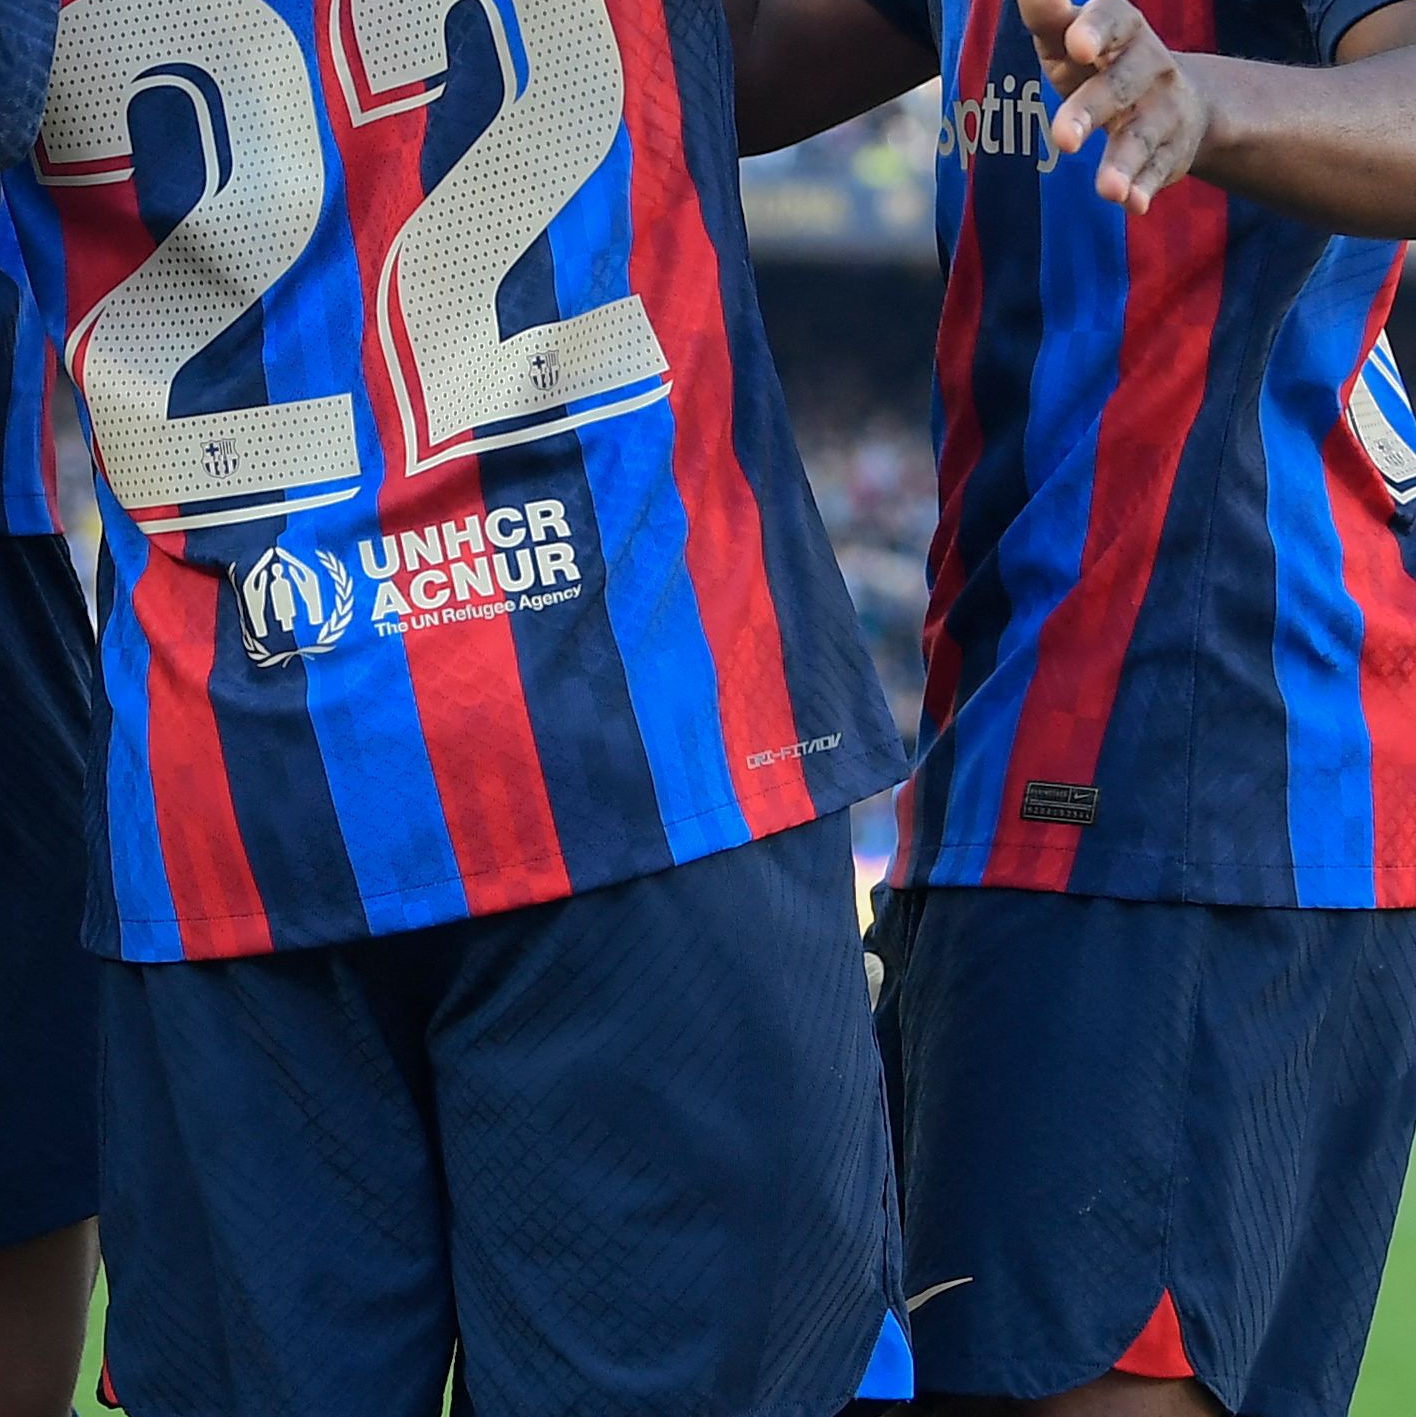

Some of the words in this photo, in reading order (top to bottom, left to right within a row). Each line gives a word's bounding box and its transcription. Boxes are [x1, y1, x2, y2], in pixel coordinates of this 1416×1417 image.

[358, 499, 572, 579] UNHCR
[370, 542, 582, 621] ACNUR
[374, 621, 409, 637] The
[411, 611, 440, 629] UN
[442, 600, 516, 624] Refugee
[519, 584, 582, 611] Agency
